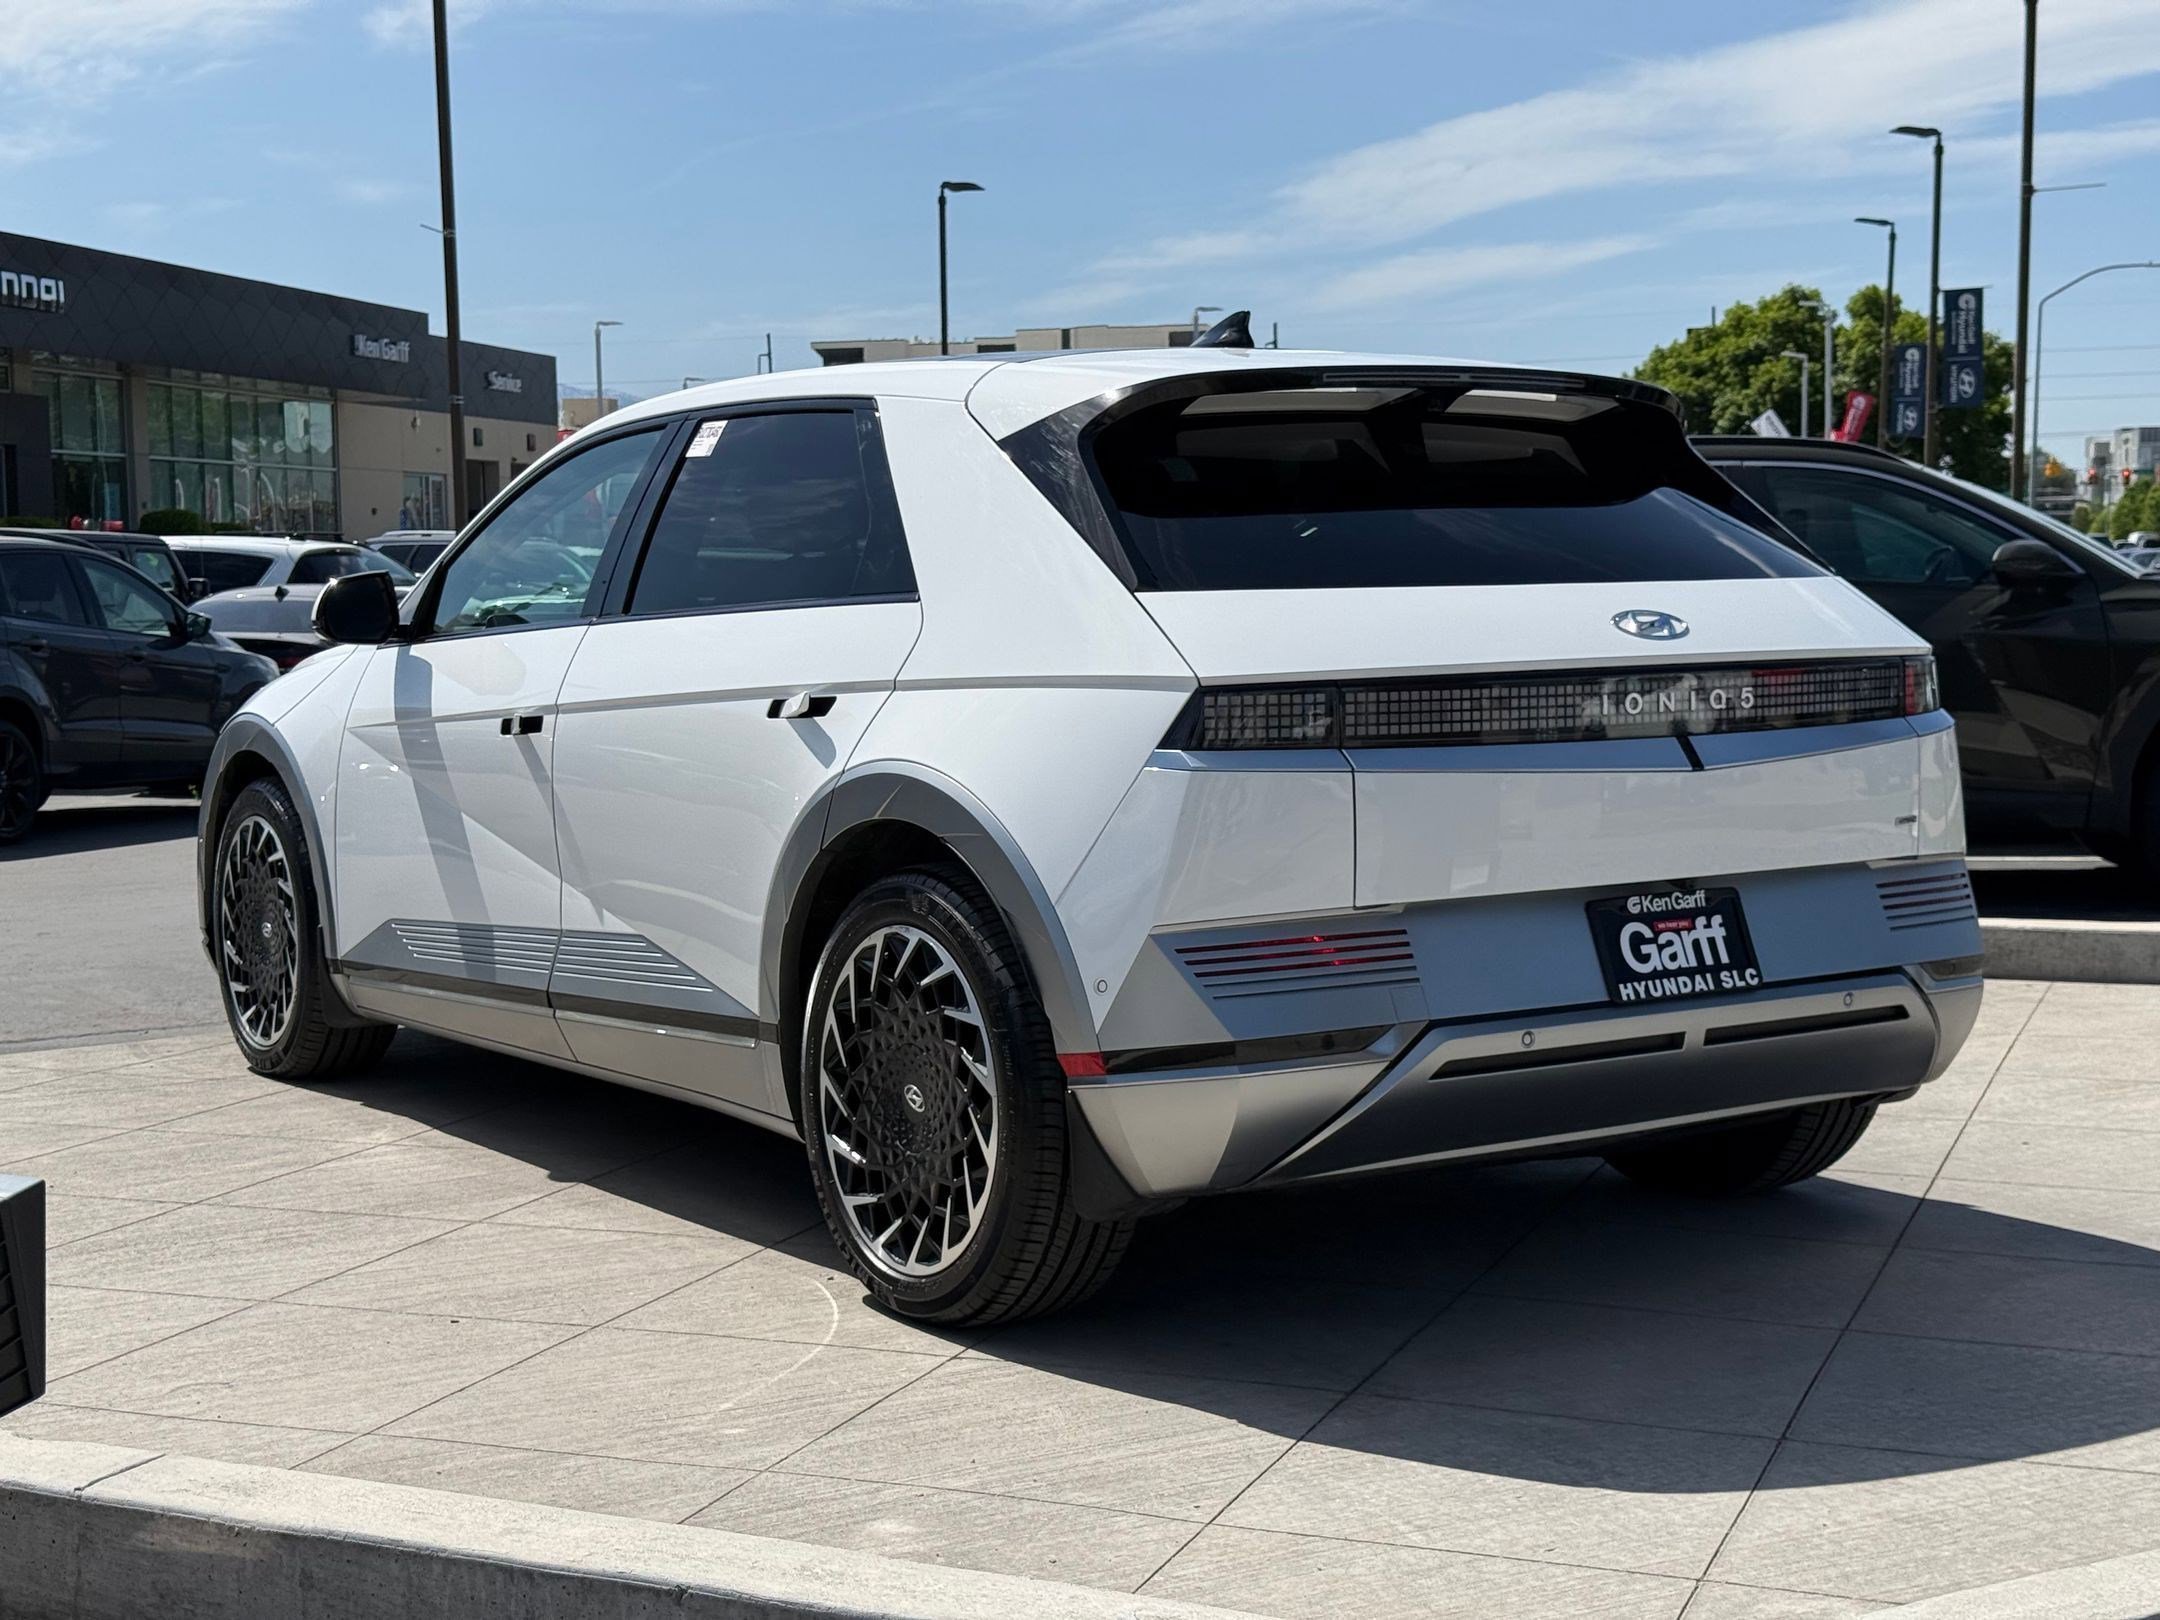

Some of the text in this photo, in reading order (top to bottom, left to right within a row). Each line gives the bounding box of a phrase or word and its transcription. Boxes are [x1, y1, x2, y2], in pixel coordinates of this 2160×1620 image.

[1620, 914, 1730, 974] Garff
[1618, 968, 1759, 1001] HYUNDAI SLC
